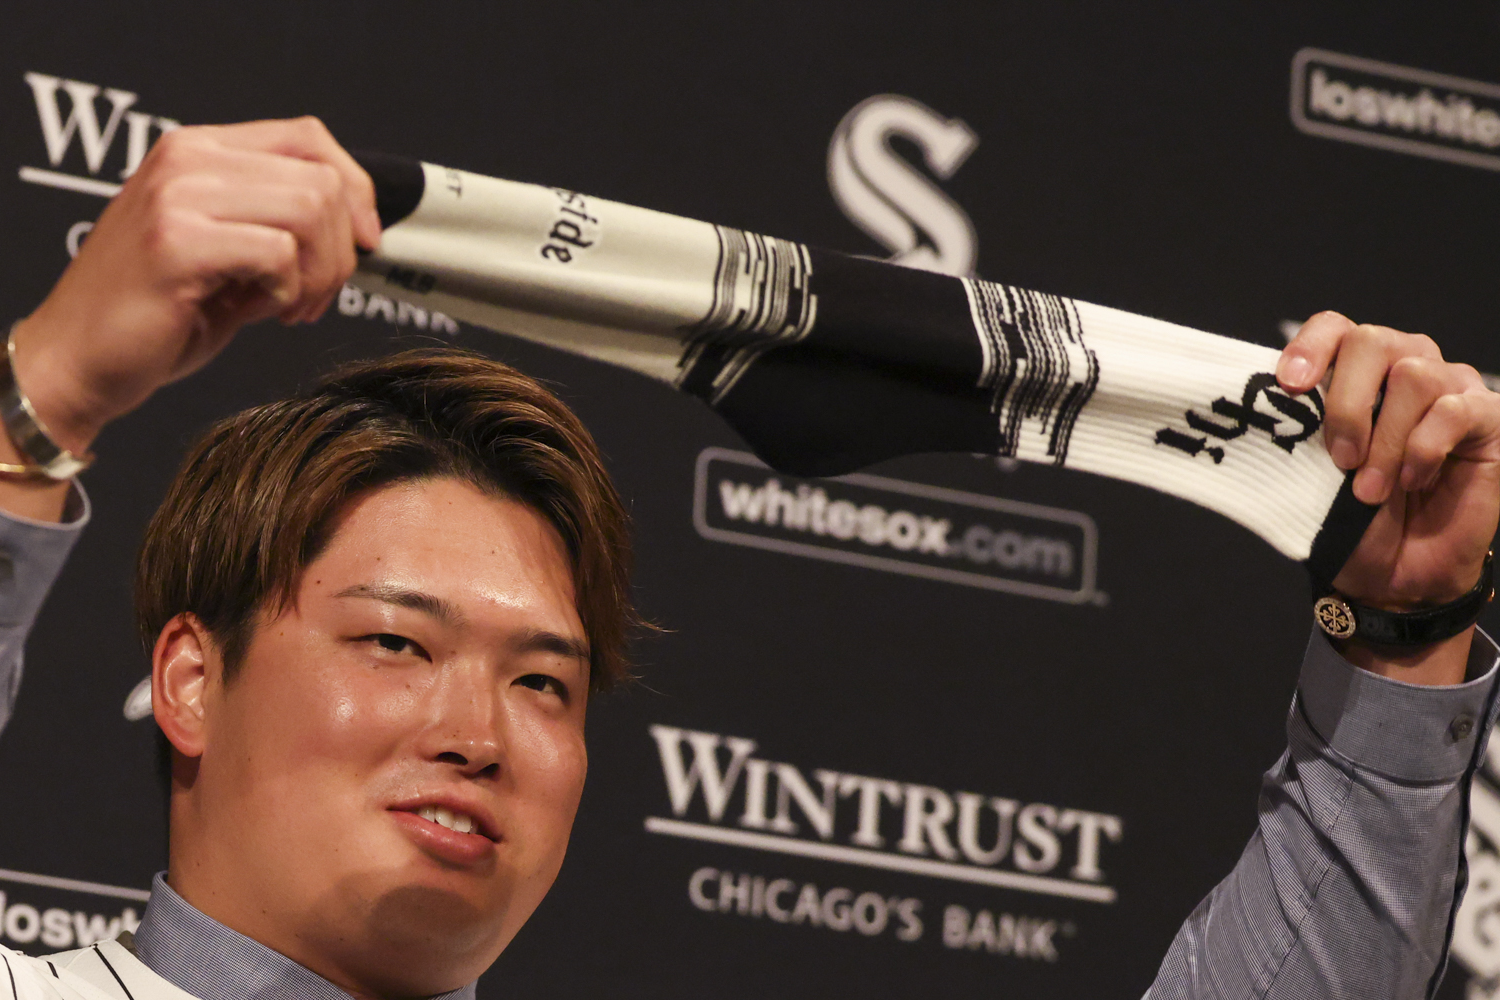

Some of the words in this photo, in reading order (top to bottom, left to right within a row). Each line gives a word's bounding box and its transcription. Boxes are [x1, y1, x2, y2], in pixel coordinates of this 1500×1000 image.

[719, 478, 1077, 577] whitesox.com
[649, 723, 1123, 881] WINTRUST
[689, 865, 925, 943] CHICAGO'S
[943, 902, 1062, 961] BANK
